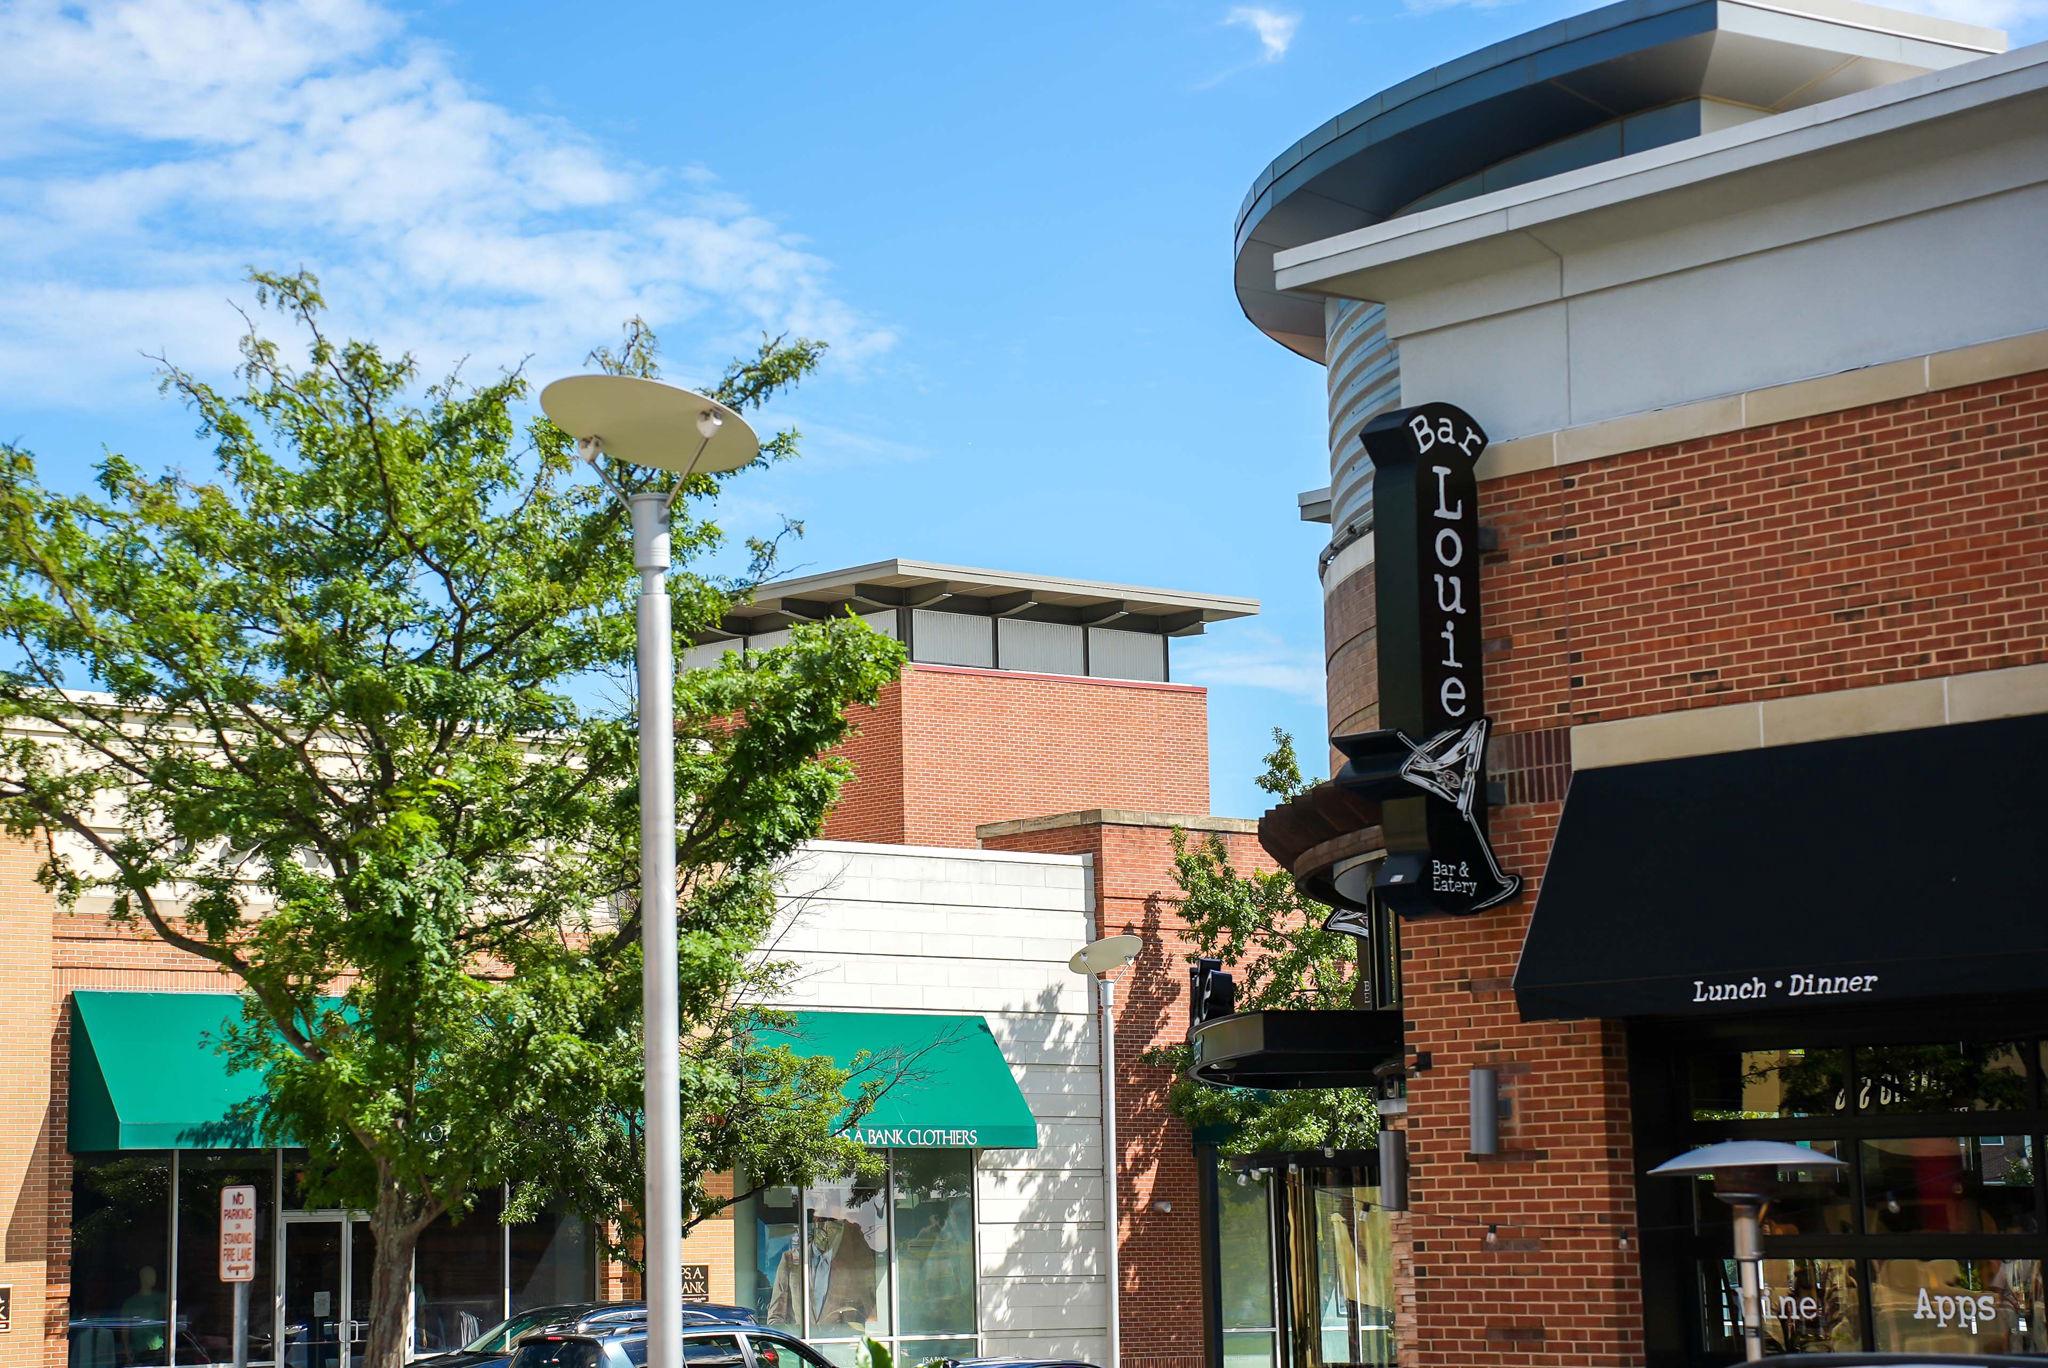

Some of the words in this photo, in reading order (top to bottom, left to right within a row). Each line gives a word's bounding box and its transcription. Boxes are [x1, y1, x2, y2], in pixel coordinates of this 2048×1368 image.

[1408, 414, 1482, 457] Bar
[1431, 465, 1467, 717] Louie
[1432, 859, 1457, 876] Bar
[1459, 861, 1470, 878] &
[1432, 876, 1478, 897] Eatery
[1692, 976, 1767, 1002] Lunch
[1788, 973, 1879, 997] Dinner
[868, 1129, 906, 1145] BANK
[907, 1129, 978, 1146] CLOTHIERS
[233, 1192, 245, 1205] NO
[224, 1208, 252, 1220] PARKING
[224, 1232, 252, 1244] STANDING
[224, 1248, 235, 1261] FIRE
[237, 1248, 252, 1261] LANE
[682, 1281, 706, 1293] ANK
[1737, 1287, 1818, 1321] ine
[1913, 1287, 1996, 1328] Apps
